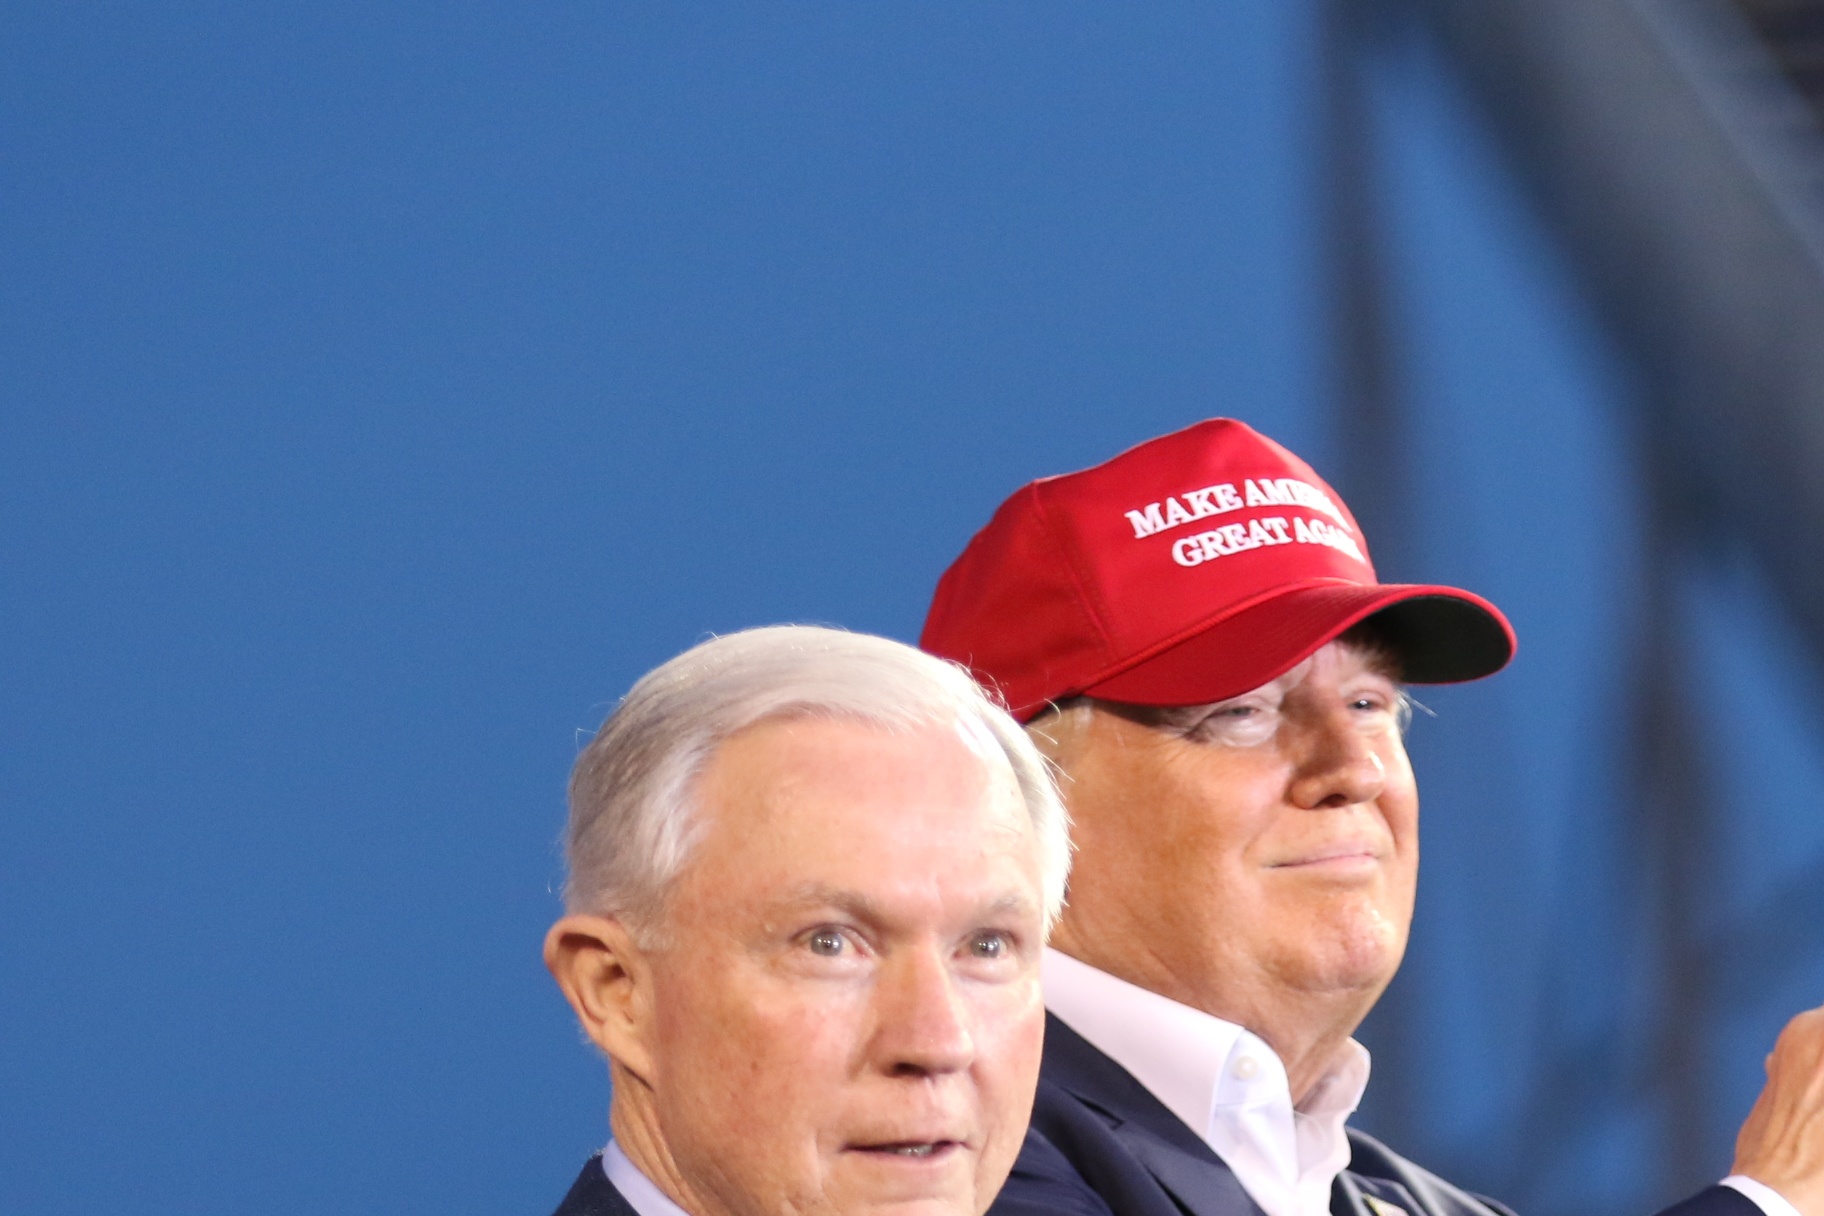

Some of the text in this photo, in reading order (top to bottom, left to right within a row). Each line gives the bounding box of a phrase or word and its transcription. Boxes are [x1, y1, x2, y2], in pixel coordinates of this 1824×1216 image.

[1124, 484, 1243, 539] MAKE
[1172, 517, 1366, 566] GREAT AGA
